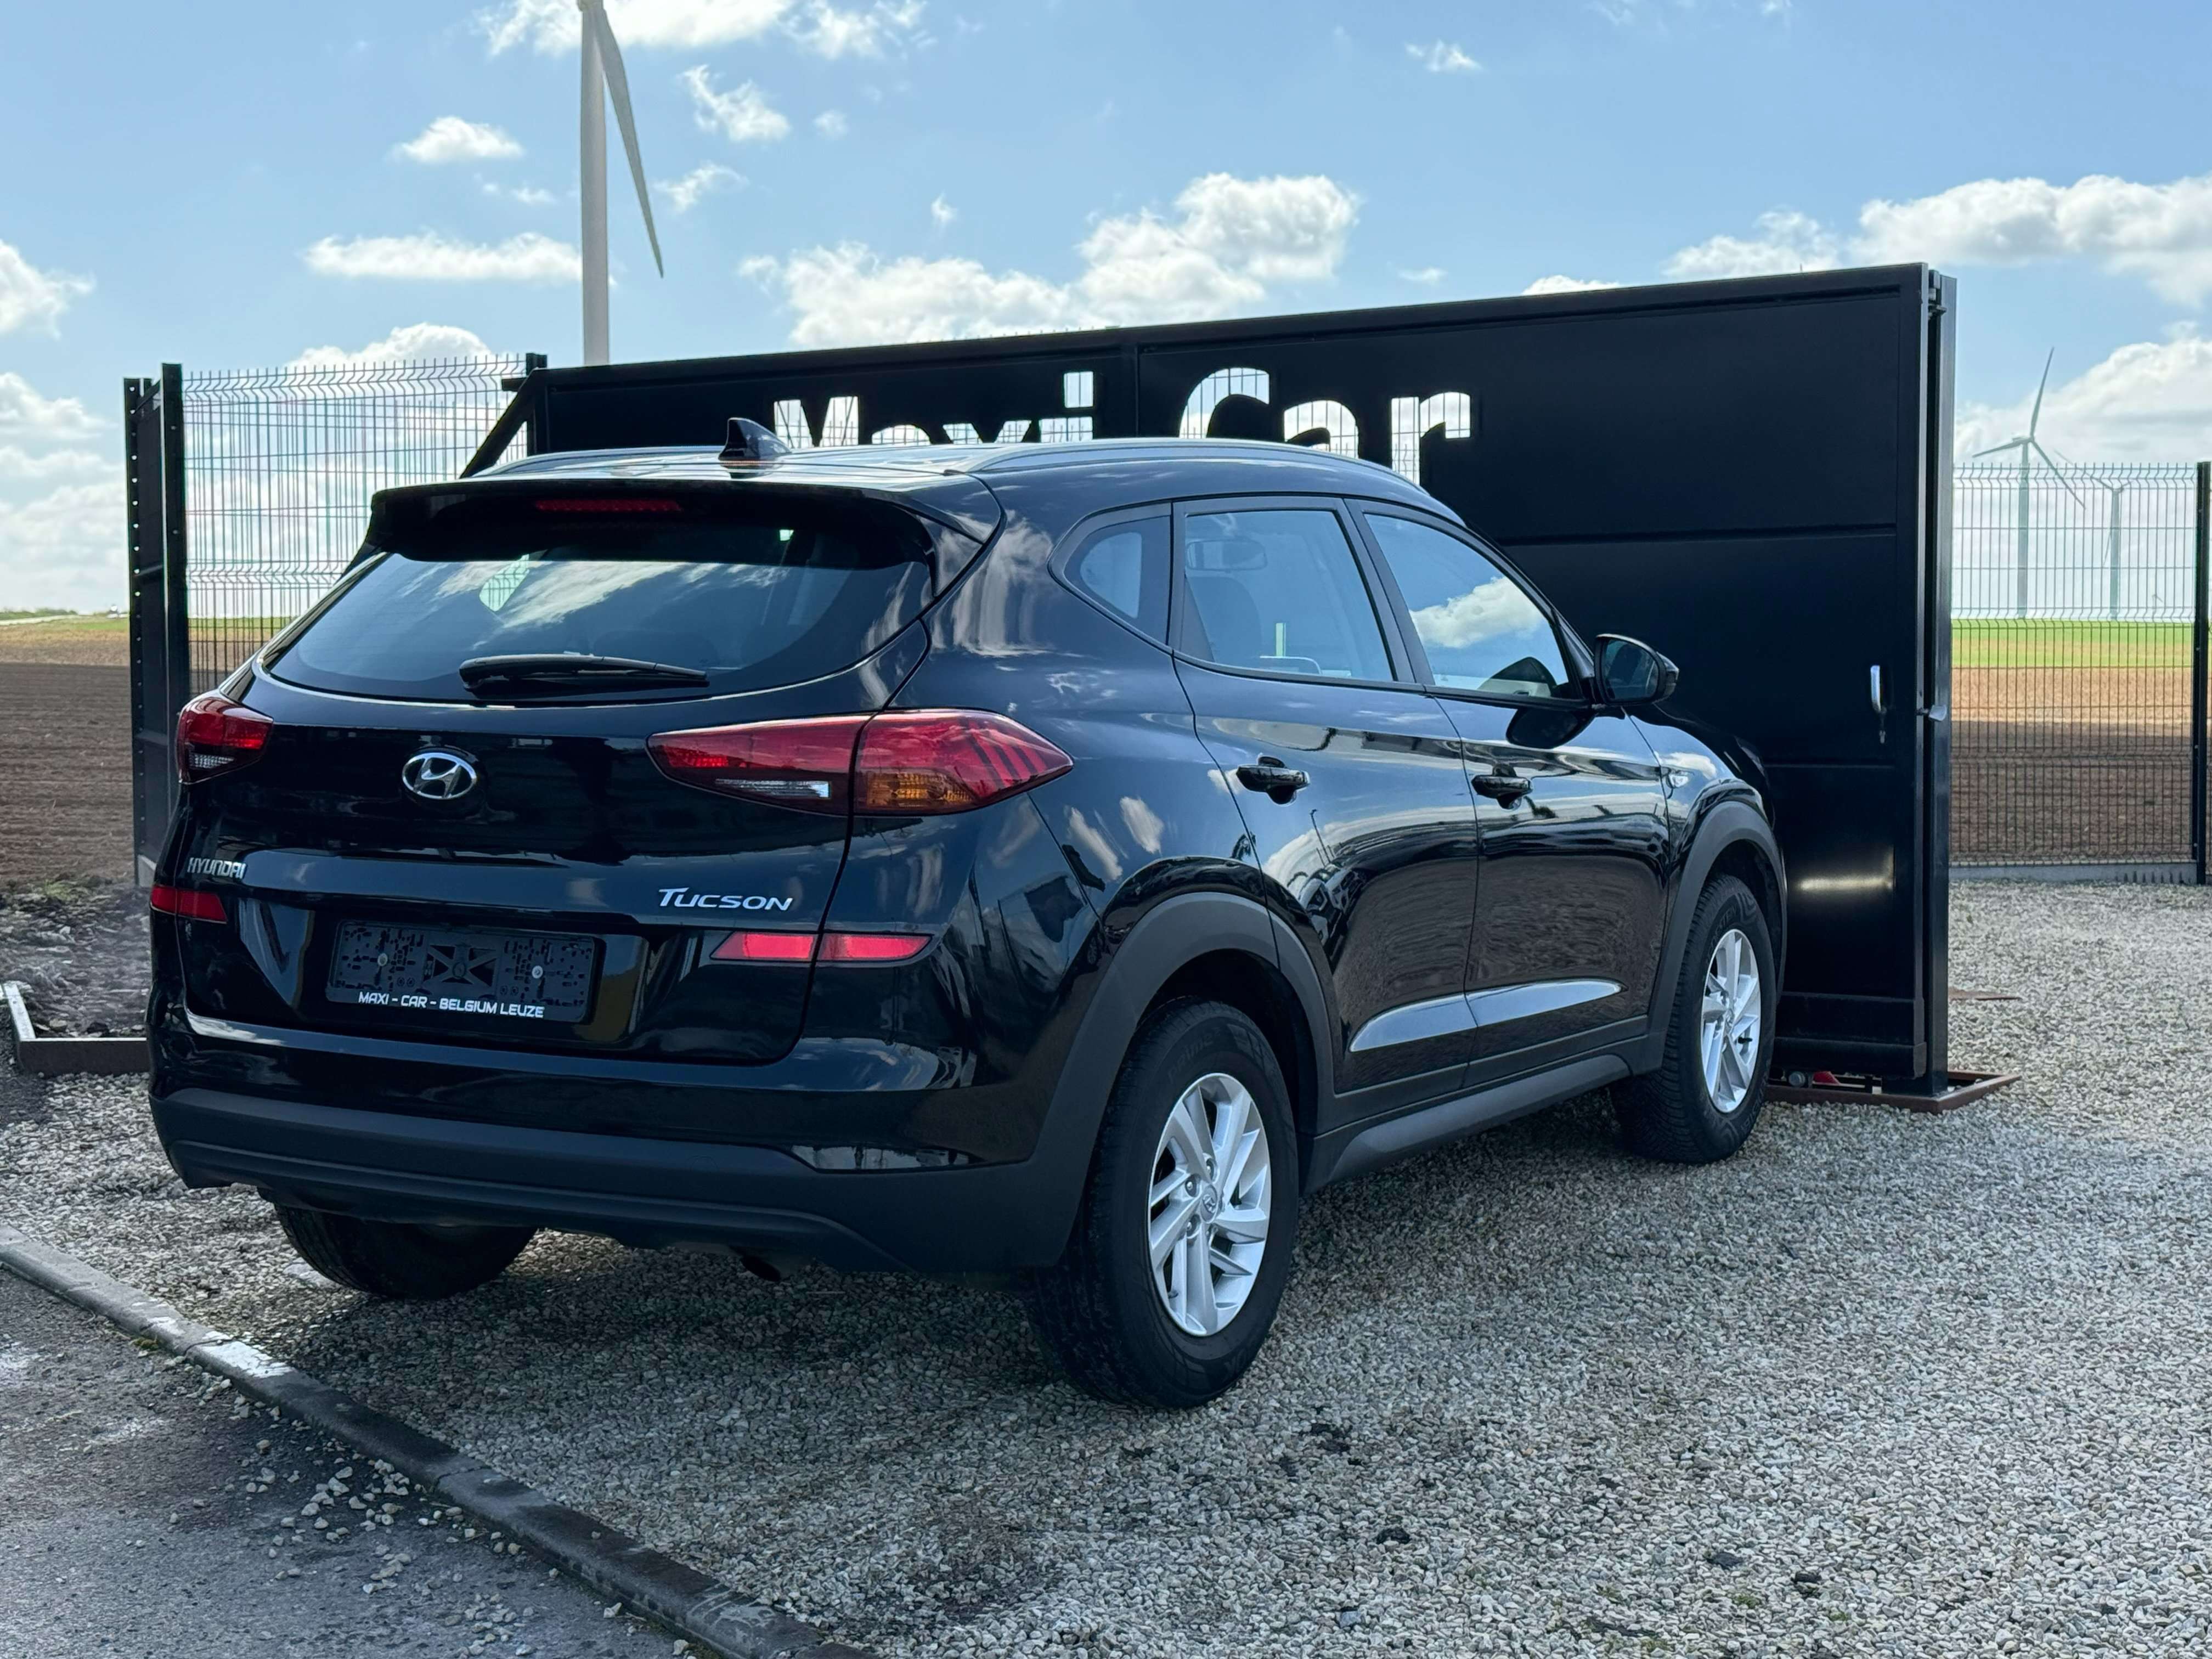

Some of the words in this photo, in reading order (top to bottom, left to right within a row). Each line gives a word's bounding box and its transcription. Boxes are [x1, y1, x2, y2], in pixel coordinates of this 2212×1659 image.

[187, 857, 247, 879] HYUNDAI
[358, 991, 390, 1005] MAXI
[400, 995, 428, 1008] CAR
[439, 998, 498, 1014] BELGIUM
[500, 1002, 545, 1018] LEUZE
